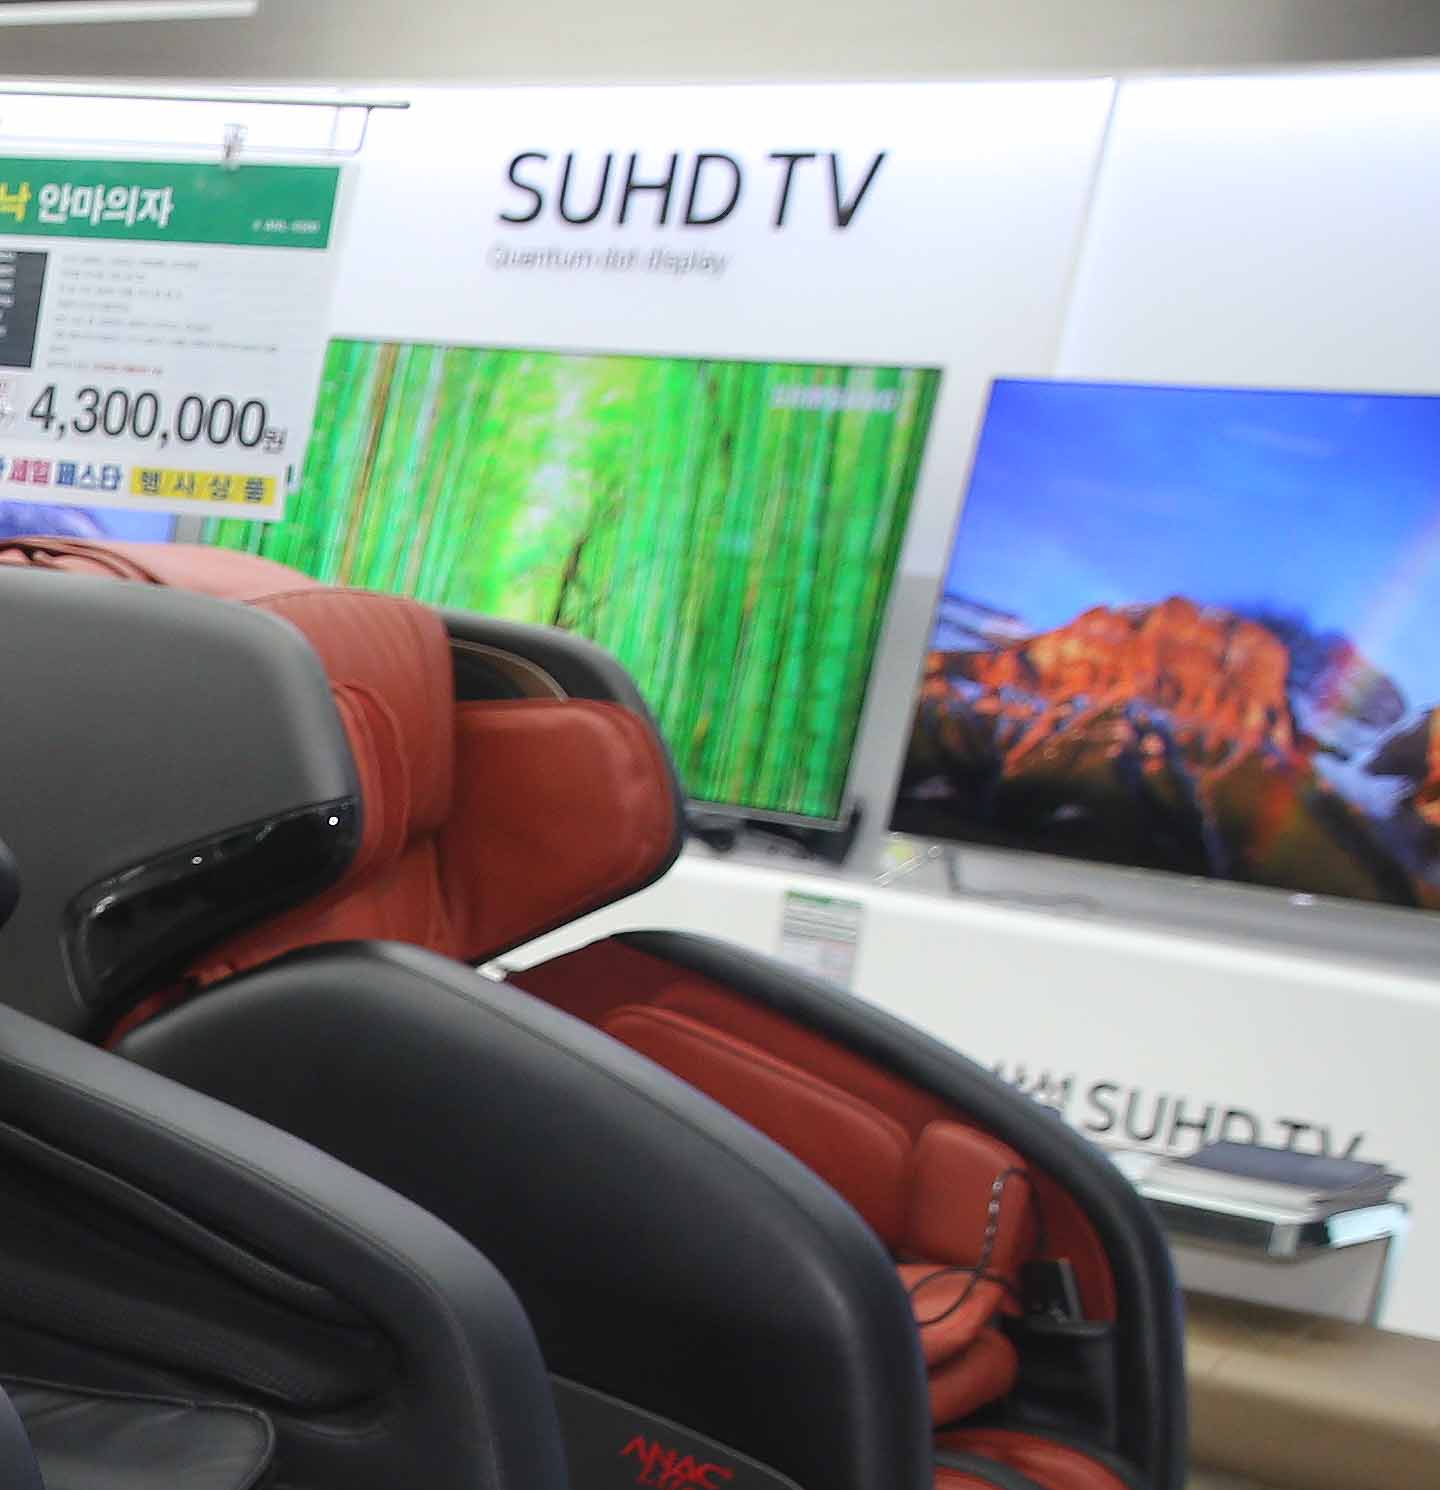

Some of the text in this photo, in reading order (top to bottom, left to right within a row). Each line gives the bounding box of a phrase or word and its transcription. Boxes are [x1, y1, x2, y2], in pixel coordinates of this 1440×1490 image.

[37, 181, 175, 229] 안마의자
[500, 152, 887, 228] SUHD TV
[1086, 1083, 1261, 1148] SUHD
